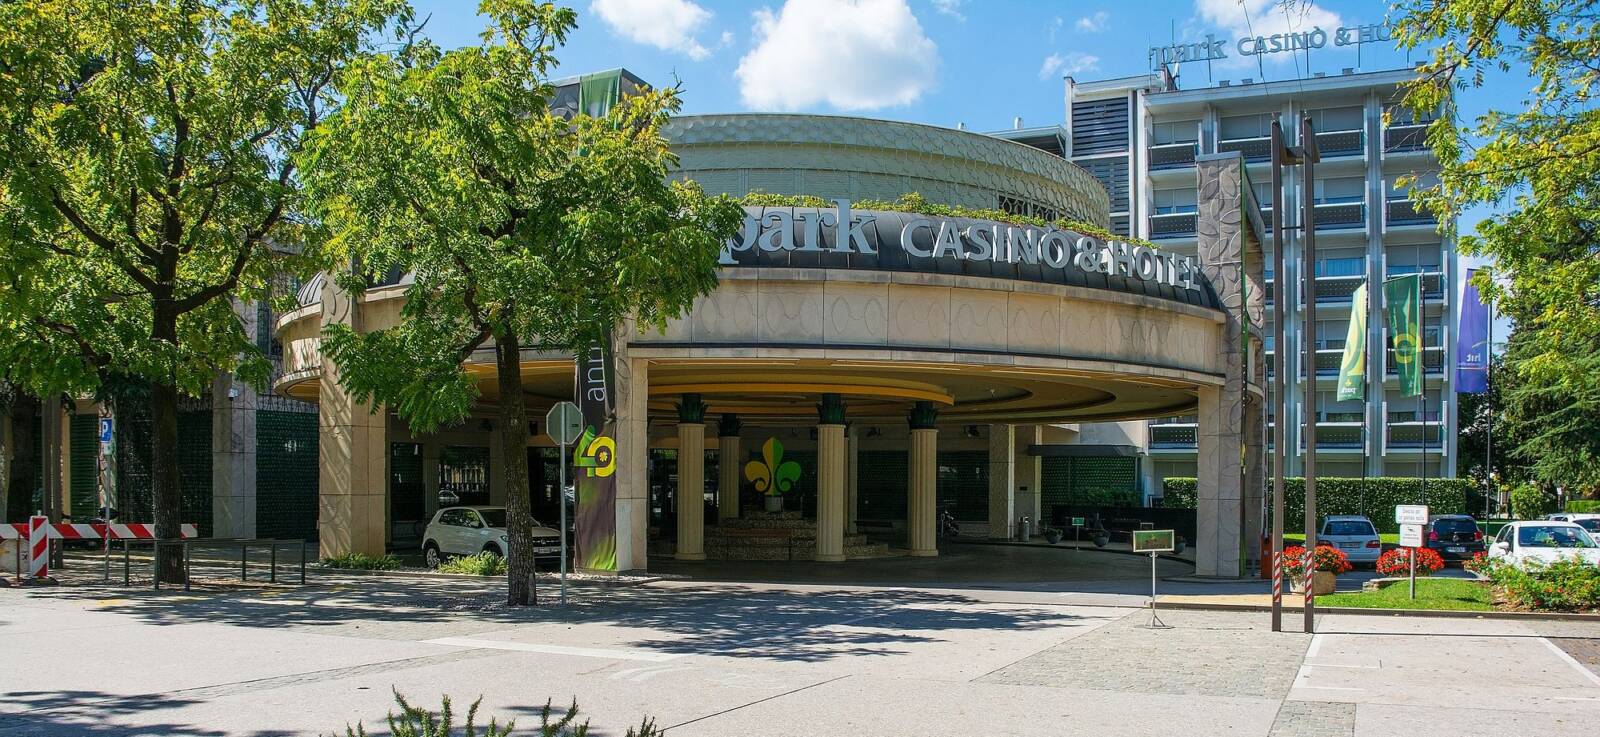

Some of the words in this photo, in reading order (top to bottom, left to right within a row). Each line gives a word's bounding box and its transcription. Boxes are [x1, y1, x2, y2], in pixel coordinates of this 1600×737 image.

[1150, 34, 1227, 71] park
[1237, 26, 1327, 56] CASINÒ
[1334, 27, 1352, 47] &
[1074, 236, 1105, 272] &
[1107, 240, 1200, 291] HOTEL
[102, 421, 108, 438] P
